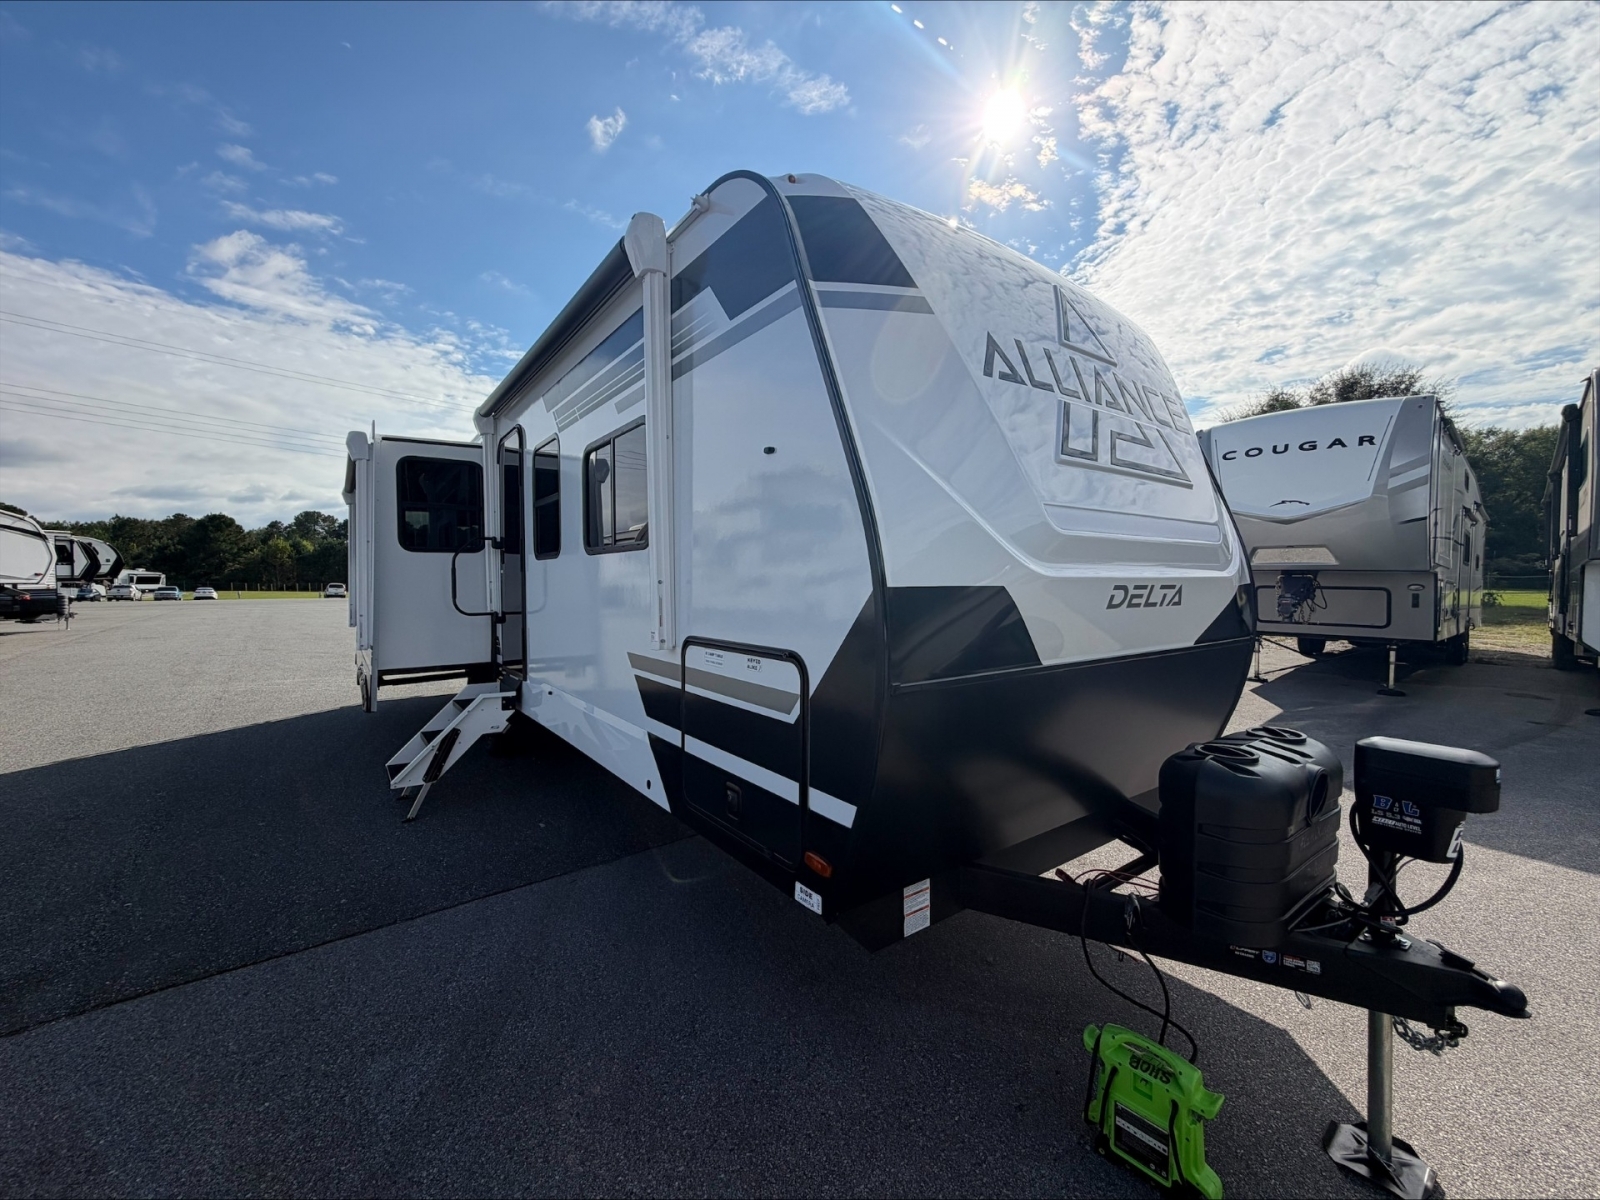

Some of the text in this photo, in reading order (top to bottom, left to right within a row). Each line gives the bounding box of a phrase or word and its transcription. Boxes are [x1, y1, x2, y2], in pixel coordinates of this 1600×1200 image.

[983, 331, 1191, 435] ALLIANCE
[1222, 434, 1377, 462] COUGAR
[1106, 584, 1183, 610] DELTA
